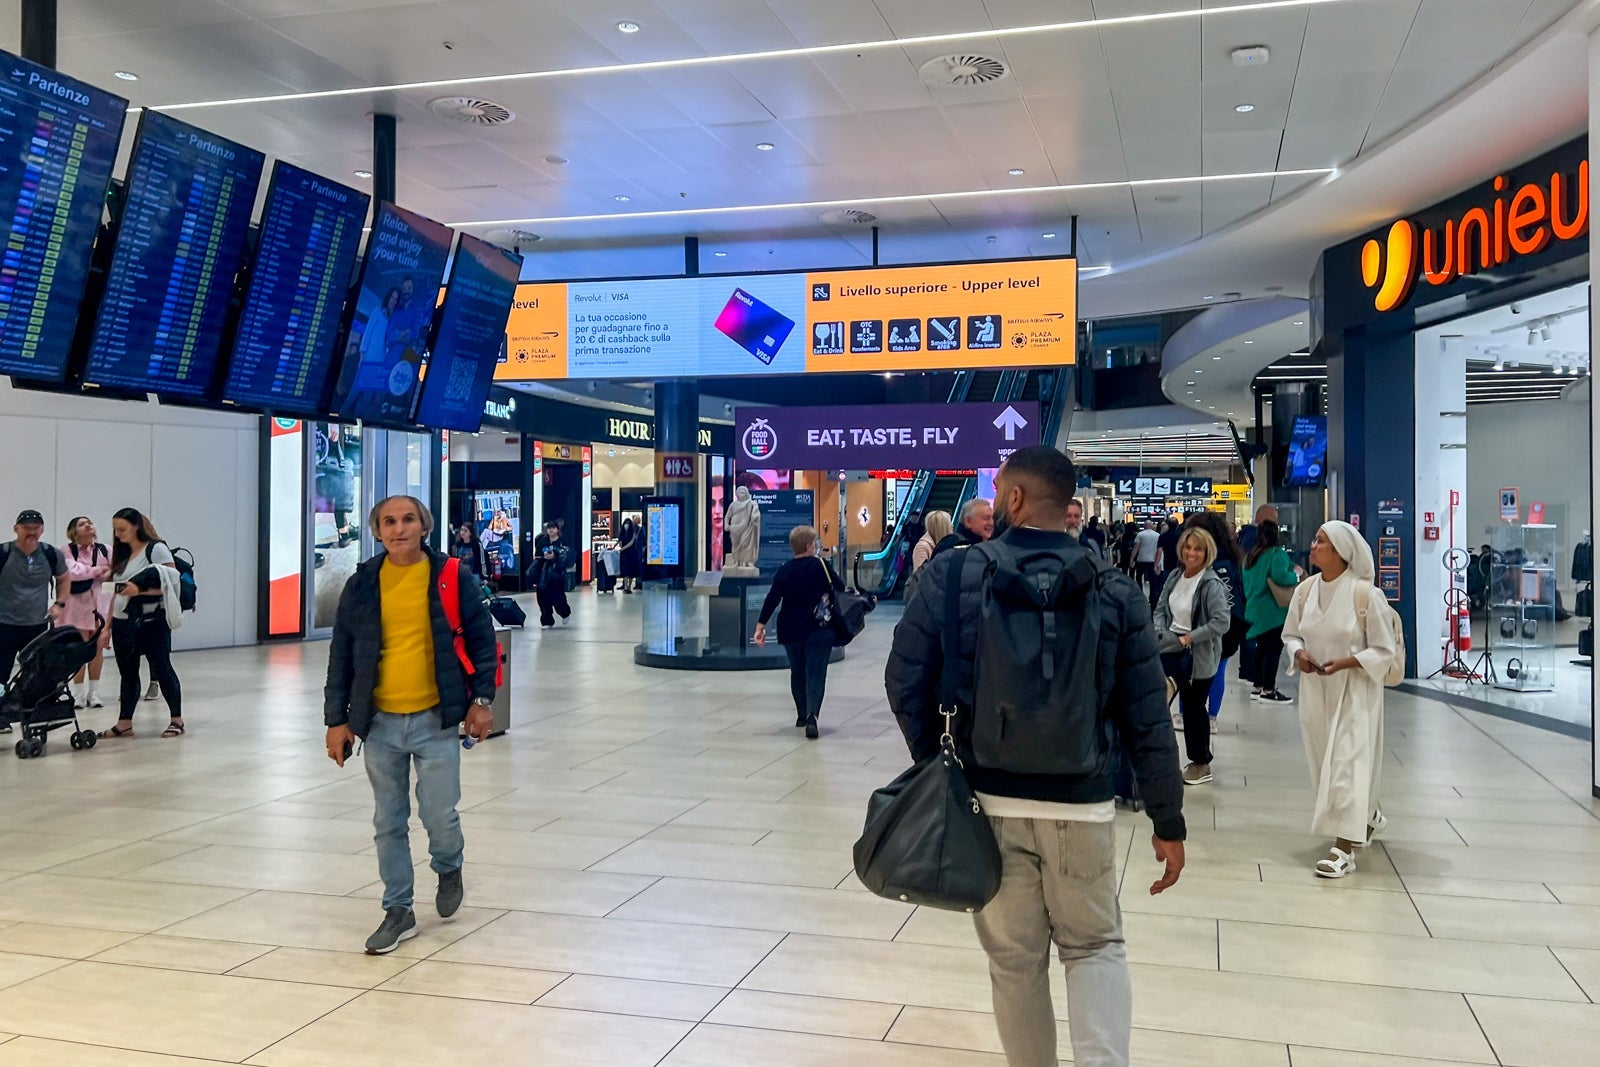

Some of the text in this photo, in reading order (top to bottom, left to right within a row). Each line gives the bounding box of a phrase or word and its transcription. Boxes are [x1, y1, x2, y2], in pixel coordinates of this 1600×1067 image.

[29, 72, 90, 106] Partenze
[189, 133, 235, 161] Partenze
[311, 180, 347, 203] Partenze
[383, 213, 409, 233] Relax
[1423, 159, 1589, 286] unieu
[379, 231, 423, 257] and enjoy
[374, 245, 419, 269] your time
[574, 293, 630, 302] Revolut VISA
[839, 284, 882, 298] Livello
[885, 281, 948, 298] superiore
[961, 279, 1004, 294] Upper
[1008, 276, 1040, 289] level
[735, 291, 754, 307] Revolut
[575, 312, 647, 322] La tua occasione
[575, 325, 590, 336] per
[591, 323, 642, 335] guadagnare
[643, 323, 662, 332] fino
[575, 332, 671, 344] 20 € di cashback sulla
[575, 344, 651, 357] prima transazione
[756, 348, 771, 364] VISA
[610, 418, 650, 441] HOUR
[807, 427, 959, 449] EAT, TASTE, FLY
[1175, 480, 1209, 493] E 1-4
